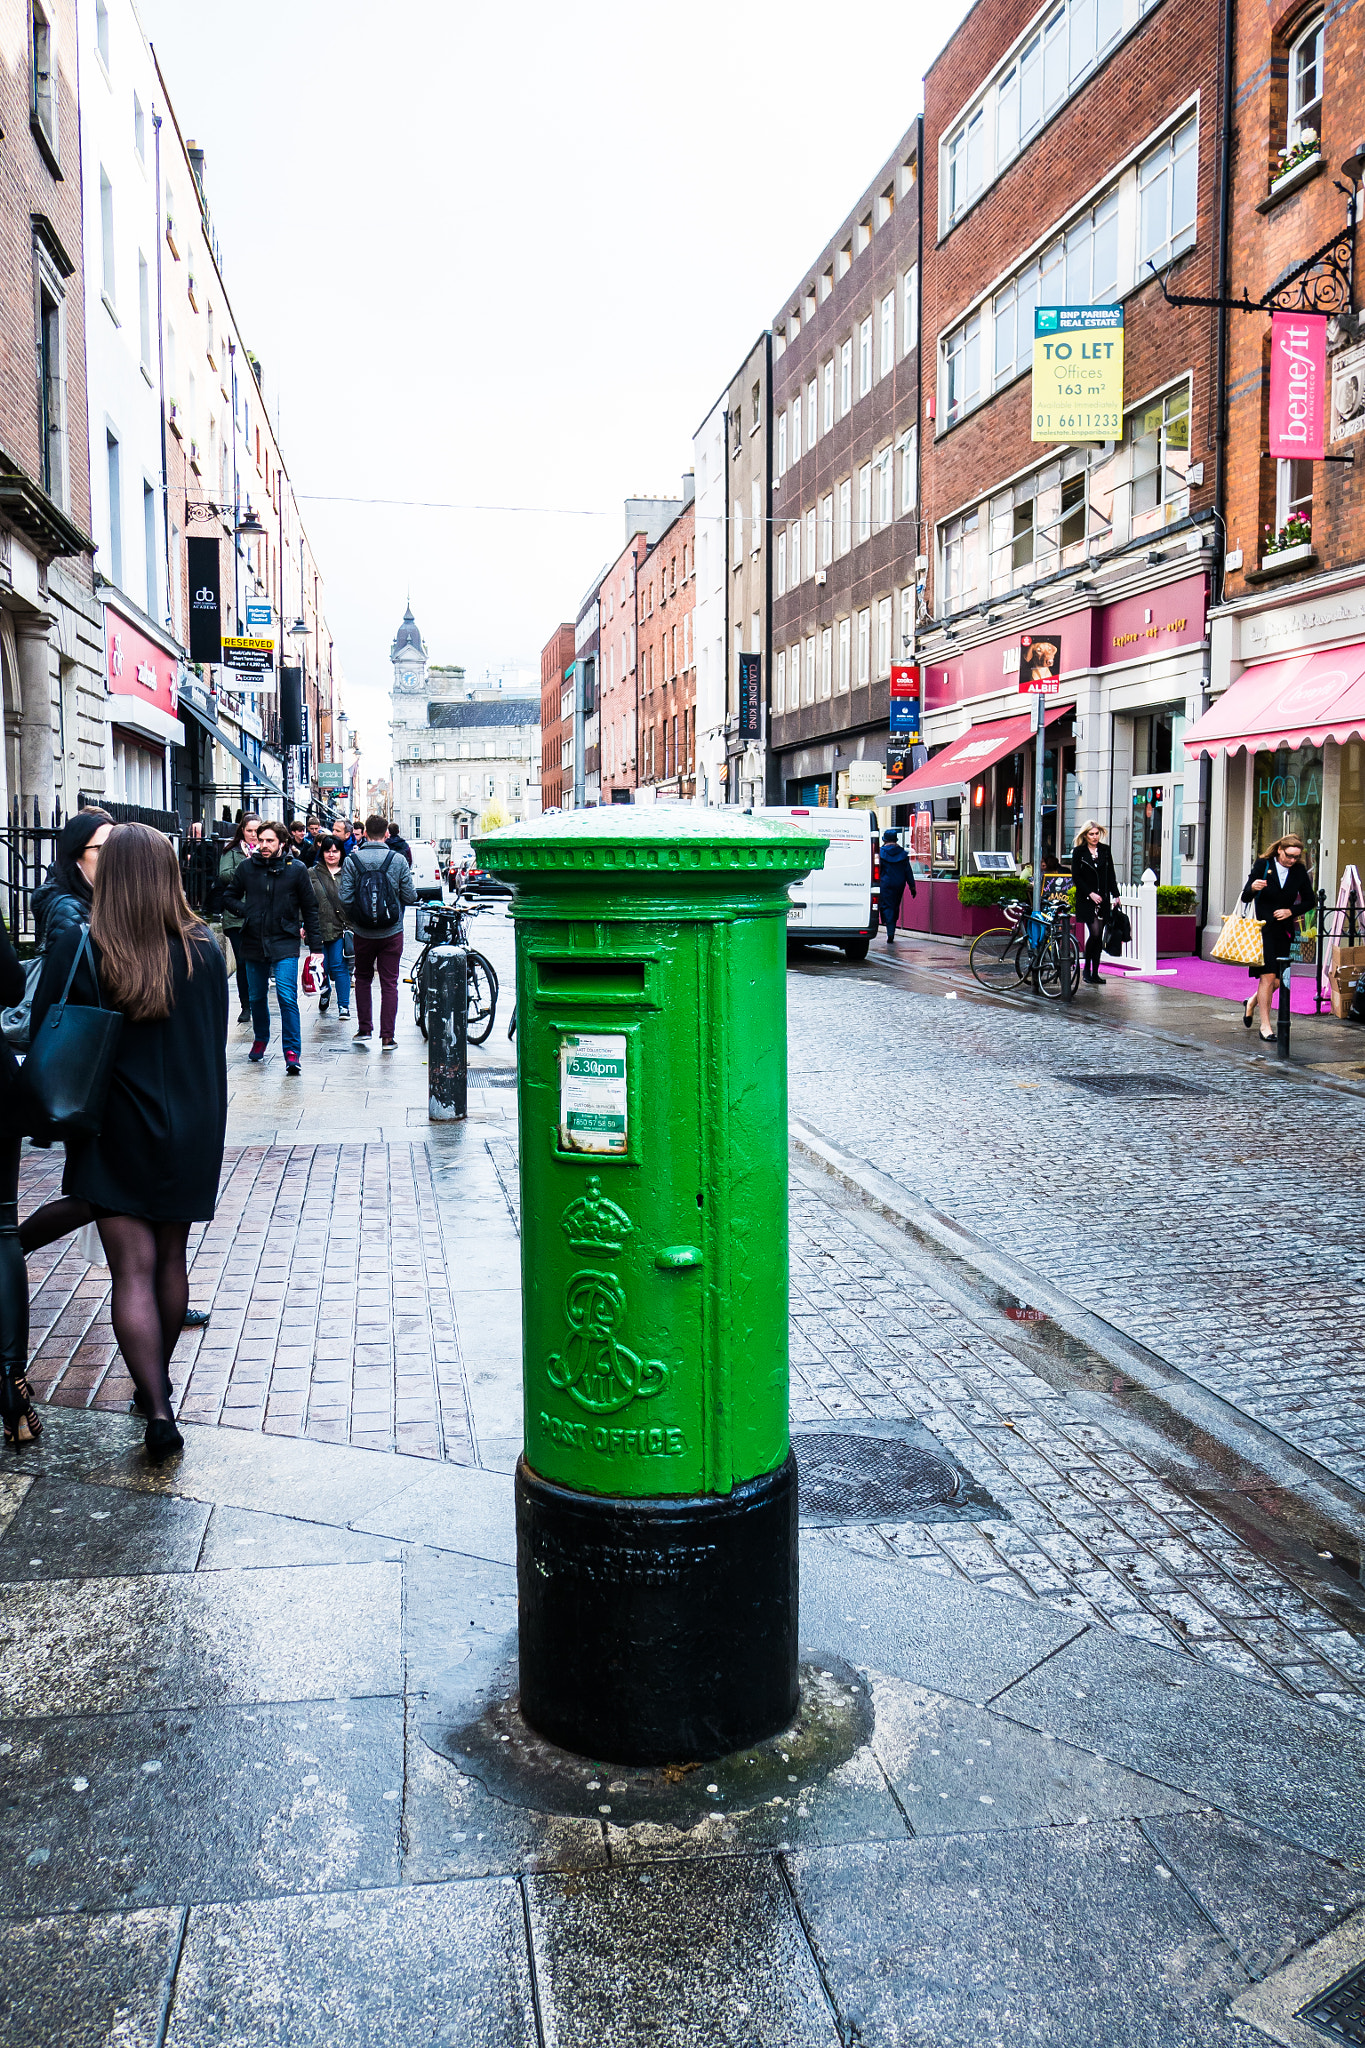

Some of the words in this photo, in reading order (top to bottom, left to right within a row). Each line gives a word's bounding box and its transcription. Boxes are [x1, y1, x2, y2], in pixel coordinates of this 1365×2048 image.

[1060, 311, 1080, 319] BNP
[1081, 310, 1120, 318] PARIBAS
[1060, 319, 1083, 327] REAL
[1043, 343, 1072, 360] TO
[1082, 343, 1114, 359] LET
[1054, 364, 1103, 379] Offices
[1058, 384, 1082, 395] 163
[1279, 325, 1316, 444] benefit
[1036, 414, 1051, 427] 01
[1059, 414, 1118, 427] 6611233
[1113, 633, 1138, 647] Explore
[1146, 625, 1159, 639] eat
[1167, 618, 1187, 632] enjoy
[225, 638, 272, 648] RESERVED
[749, 664, 758, 706] CLAUDINE
[1028, 684, 1058, 693] ALBIE
[749, 708, 757, 730] KING
[1258, 773, 1320, 808] HOOLA
[1132, 810, 1144, 886] ZARAGOZ
[572, 1060, 617, 1076] 5.30pm
[573, 1118, 588, 1126] 1850
[539, 1411, 588, 1450] POST
[593, 1426, 683, 1456] OFFICE
